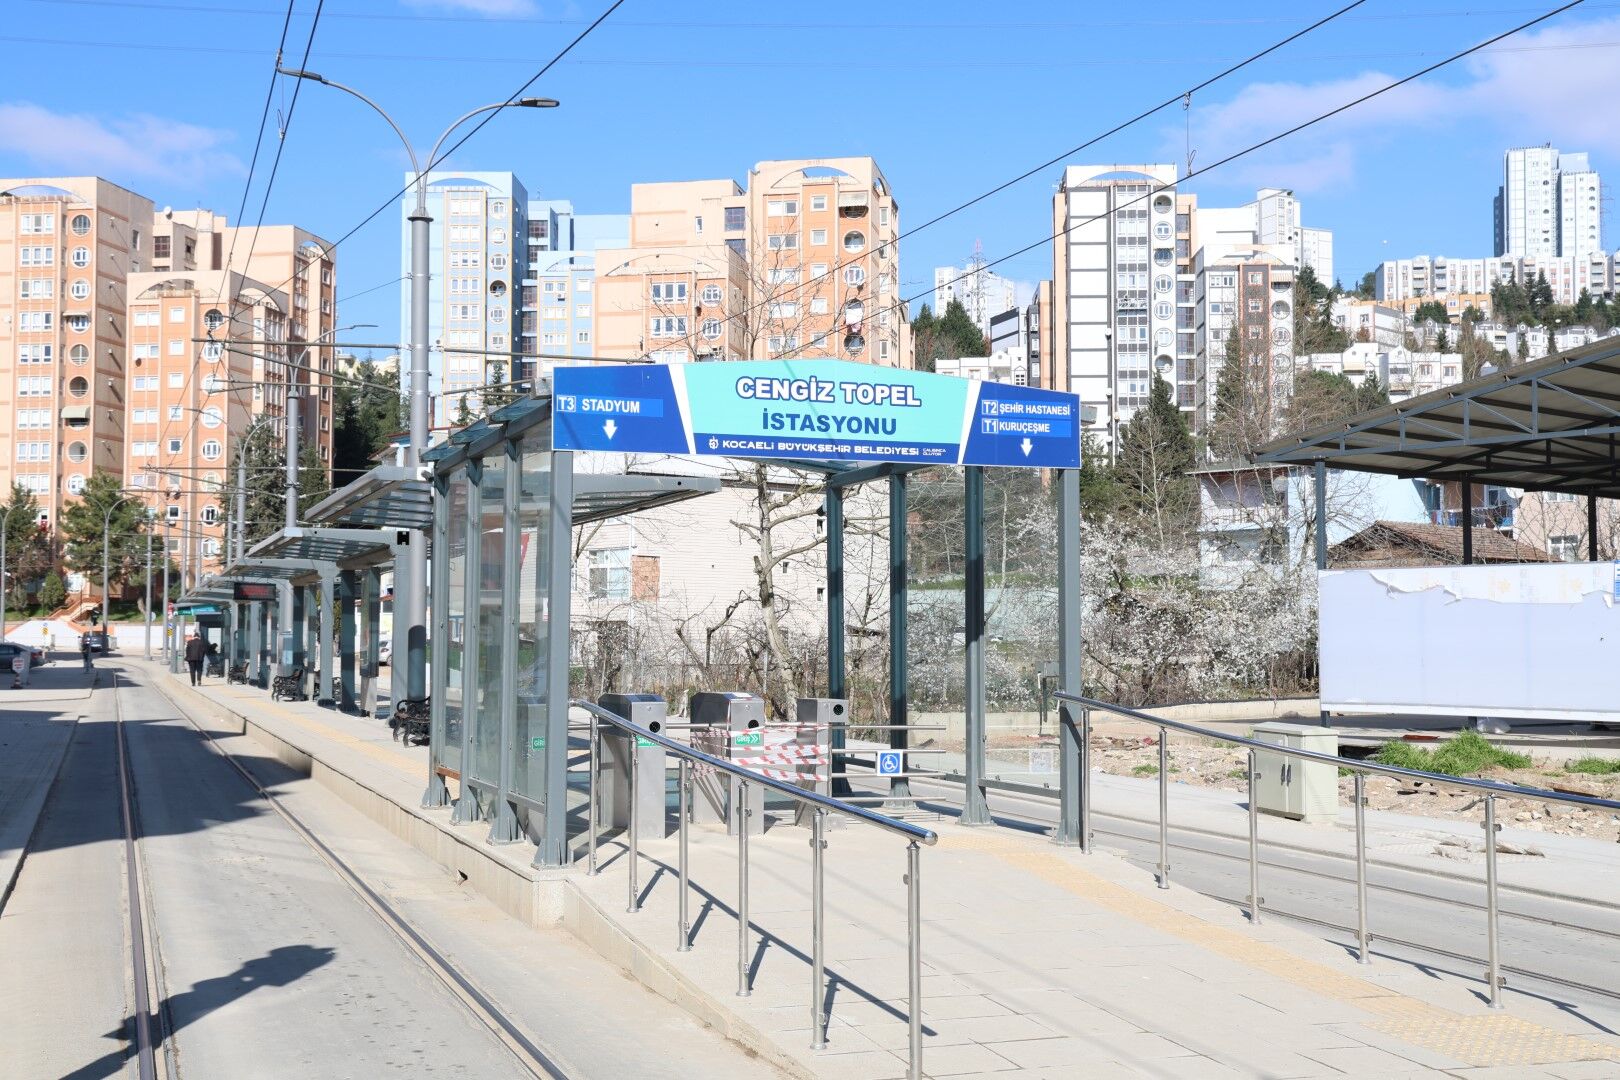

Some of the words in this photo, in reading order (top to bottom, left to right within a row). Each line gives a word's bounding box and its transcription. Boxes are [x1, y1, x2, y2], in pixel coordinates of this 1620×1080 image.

[736, 375, 835, 403] CENGİZ
[840, 381, 922, 407] TOPEL
[558, 397, 575, 411] T3
[581, 398, 640, 413] STADYUM
[983, 401, 997, 414] T2
[1000, 402, 1024, 414] ŞEHİR
[1025, 403, 1070, 416] HASTANESİ
[762, 408, 897, 435] İSTASYONU
[984, 420, 998, 433] T1
[1000, 421, 1051, 434] KURUÇEŞME
[722, 440, 774, 450] KOCAELİ
[777, 441, 851, 453] BÜYÜKŞEHİR
[854, 445, 919, 456] BELEDİYESİ
